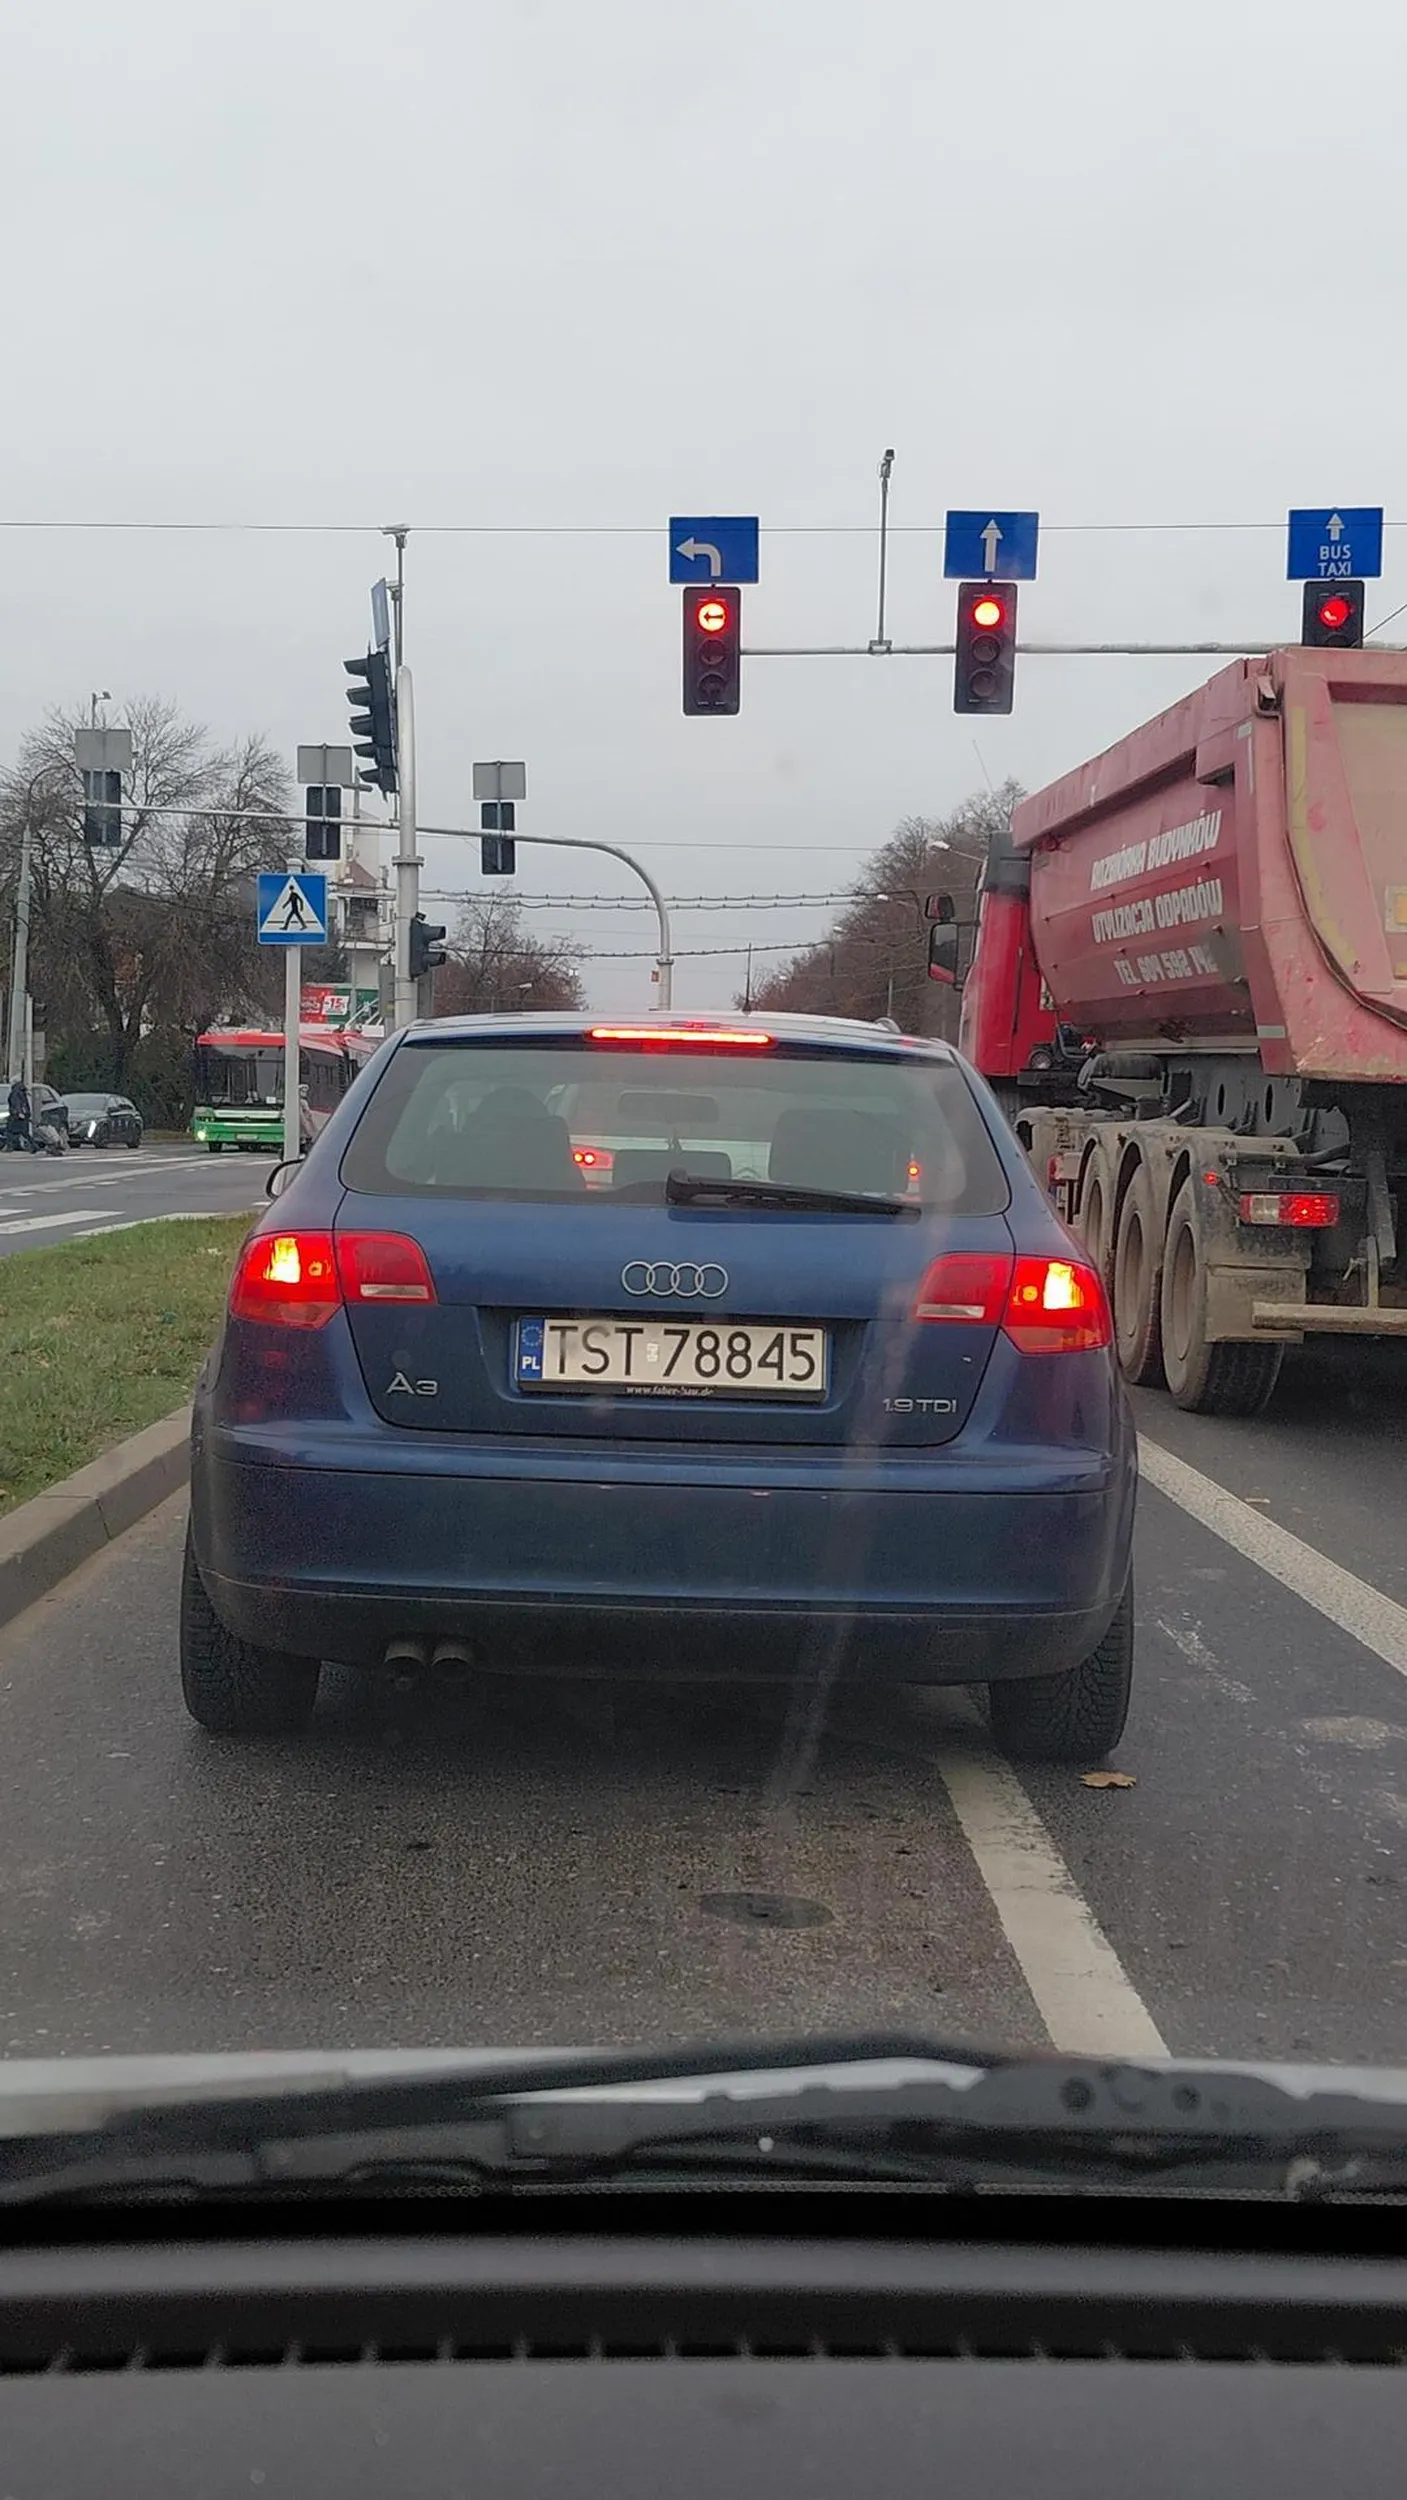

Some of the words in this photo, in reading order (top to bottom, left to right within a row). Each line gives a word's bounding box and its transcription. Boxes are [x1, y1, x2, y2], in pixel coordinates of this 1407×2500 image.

[1320, 544, 1351, 560] BUS
[1318, 561, 1352, 576] TAXI
[1147, 809, 1222, 872] BUDYNKÓW
[1091, 898, 1155, 944] UTYLIZACJA
[1155, 876, 1223, 928] ODPADÓW
[548, 1325, 644, 1375] TST
[662, 1329, 816, 1381] 78845
[521, 1357, 541, 1371] PL
[386, 1372, 438, 1395] A3
[882, 1398, 913, 1412] 1.9
[916, 1399, 957, 1412] TDI
